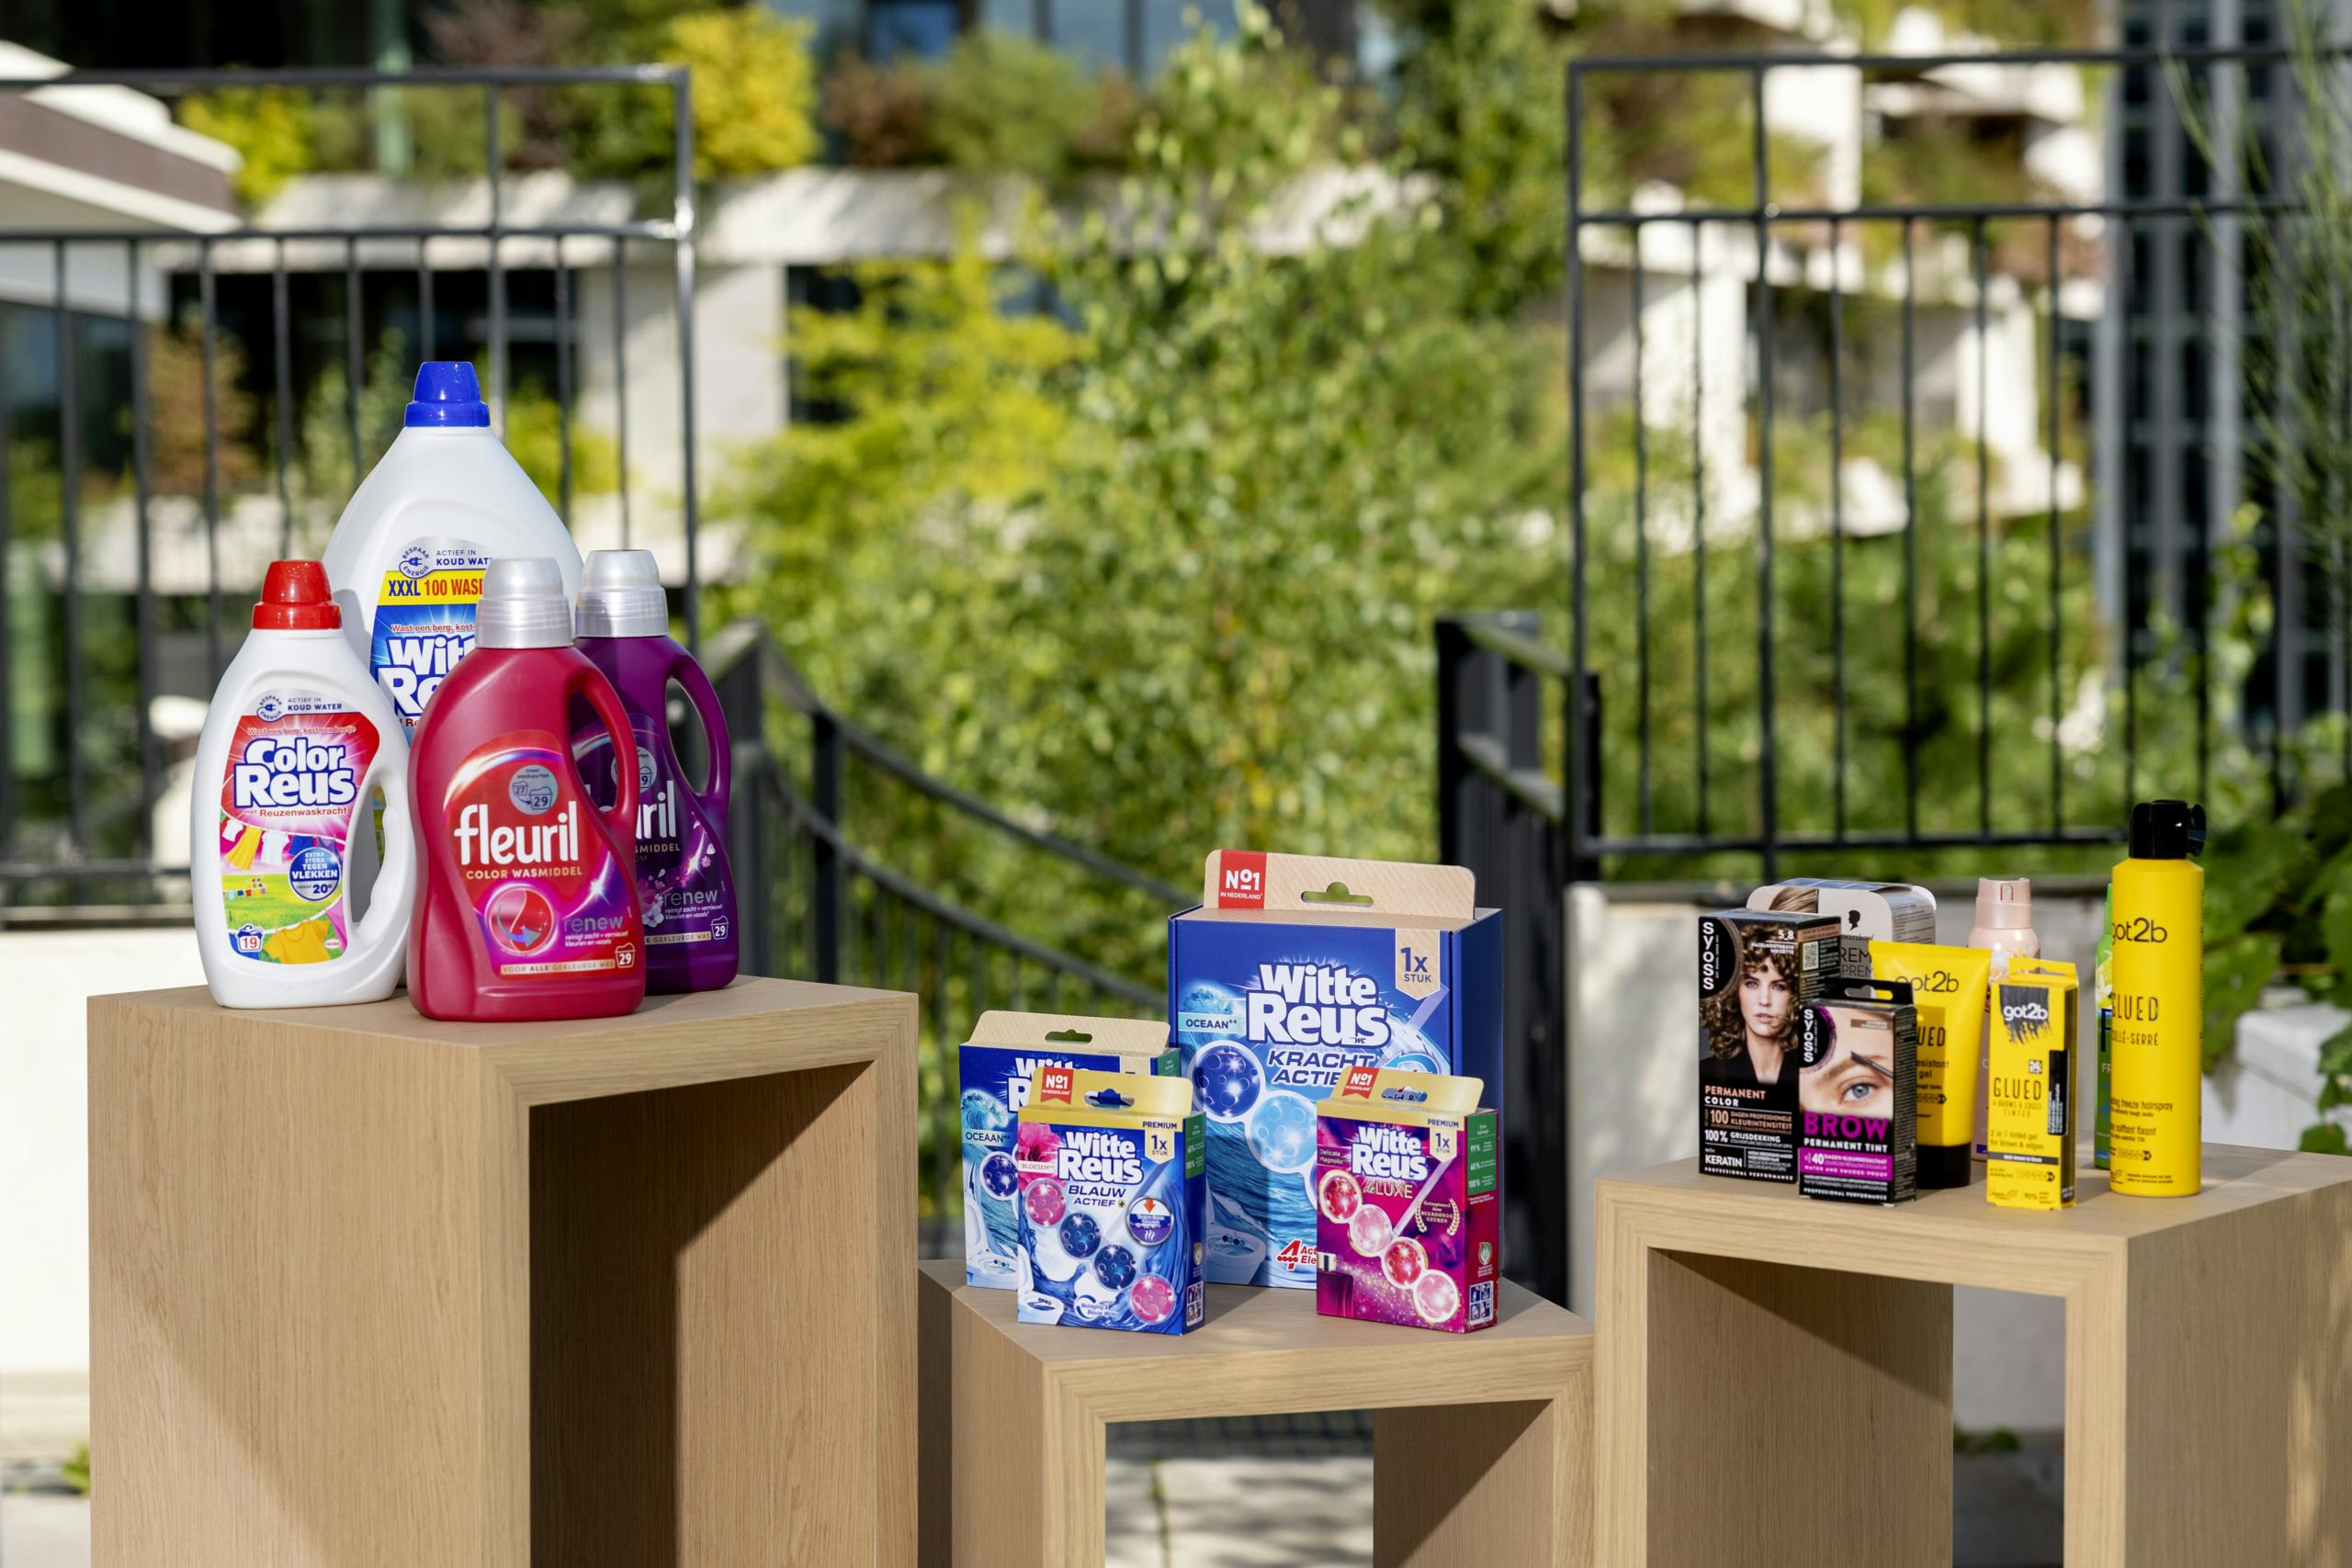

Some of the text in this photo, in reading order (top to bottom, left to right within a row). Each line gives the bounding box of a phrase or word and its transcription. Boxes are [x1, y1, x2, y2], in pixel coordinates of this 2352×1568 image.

[402, 547, 429, 559] BESPAAR
[436, 557, 492, 566] KOUD WAT
[403, 565, 429, 577] ENERGIE
[388, 580, 421, 596] XXXL
[424, 579, 447, 596] 100
[433, 624, 454, 635] berg,
[456, 623, 473, 631] kost
[378, 667, 446, 714] Re
[314, 703, 343, 711] WATER
[245, 738, 345, 773] Color
[235, 764, 356, 807] Reus
[534, 796, 548, 807] 29
[259, 807, 348, 818] Reuzenwaskracht
[454, 800, 579, 865] fleuril
[291, 870, 338, 880] VLEKKEN
[466, 866, 582, 880] COLOR WASMIDDEL
[663, 889, 718, 907] renew
[563, 916, 624, 932] renew
[715, 925, 726, 937] 29
[242, 937, 258, 949] 19
[653, 934, 695, 943] GEKLEURDE
[618, 953, 632, 965] 29
[1400, 947, 1429, 973] 1x
[1840, 947, 1872, 963] REM
[552, 962, 596, 971] GEKLEURDE
[1259, 964, 1377, 1006] Witte
[1404, 974, 1431, 983] STUK
[2003, 1002, 2049, 1021] got2b
[1248, 992, 1390, 1046] Reus
[1917, 1026, 1946, 1047] UED
[1269, 1050, 1374, 1068] KRACHT
[1273, 1069, 1340, 1086] ACTIE
[1704, 1085, 1766, 1100] PERMANENT
[1994, 1077, 2041, 1100] GLUED
[1704, 1096, 1739, 1107] COLOR
[1427, 1118, 1459, 1128] PREMIUM
[1710, 1110, 1729, 1124] 100
[1730, 1118, 1792, 1130] KLEURINTENSITEIT
[1142, 1121, 1178, 1130] PREMIUM
[1804, 1113, 1888, 1142] BROW
[1066, 1131, 1136, 1158] Witte
[1151, 1134, 1168, 1150] 1x
[1358, 1126, 1421, 1156] Witte
[1435, 1133, 1450, 1148] 1x
[1730, 1132, 1781, 1143] GRIJSDEKKING
[1804, 1137, 1888, 1154] PERMANENT TINT
[1319, 1149, 1341, 1157] Delicate
[1812, 1153, 1825, 1165] 40
[1058, 1148, 1143, 1185] Reus
[1351, 1144, 1428, 1181] Reus
[1704, 1155, 1743, 1168] KERATIN
[1704, 1167, 1793, 1181] PROFESSIONAL PERFORMANCE
[1068, 1184, 1127, 1198] BLAUW
[1804, 1188, 1887, 1201] PROFESSIONAL PERFORMANCE
[1073, 1198, 1116, 1207] ACTIEF
